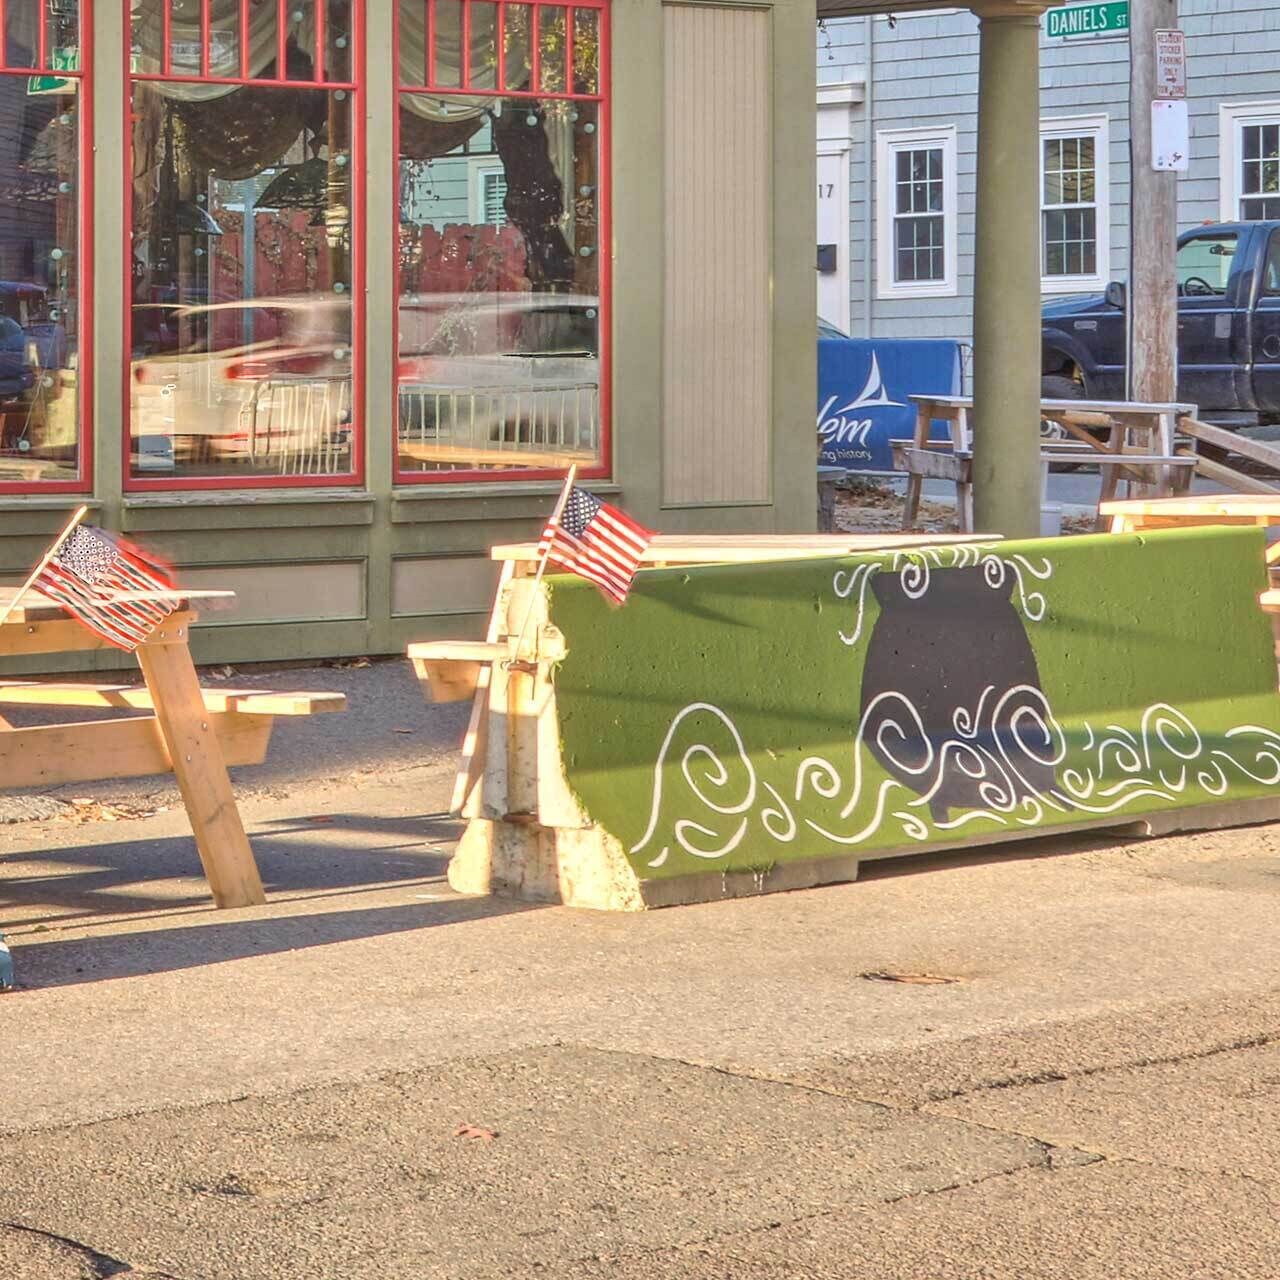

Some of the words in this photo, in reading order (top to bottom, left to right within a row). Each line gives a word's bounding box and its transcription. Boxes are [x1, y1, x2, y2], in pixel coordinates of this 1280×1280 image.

[1050, 6, 1108, 35] DANIELS
[1116, 14, 1127, 27] ST
[1159, 56, 1183, 65] PARKING
[837, 448, 872, 461] history
